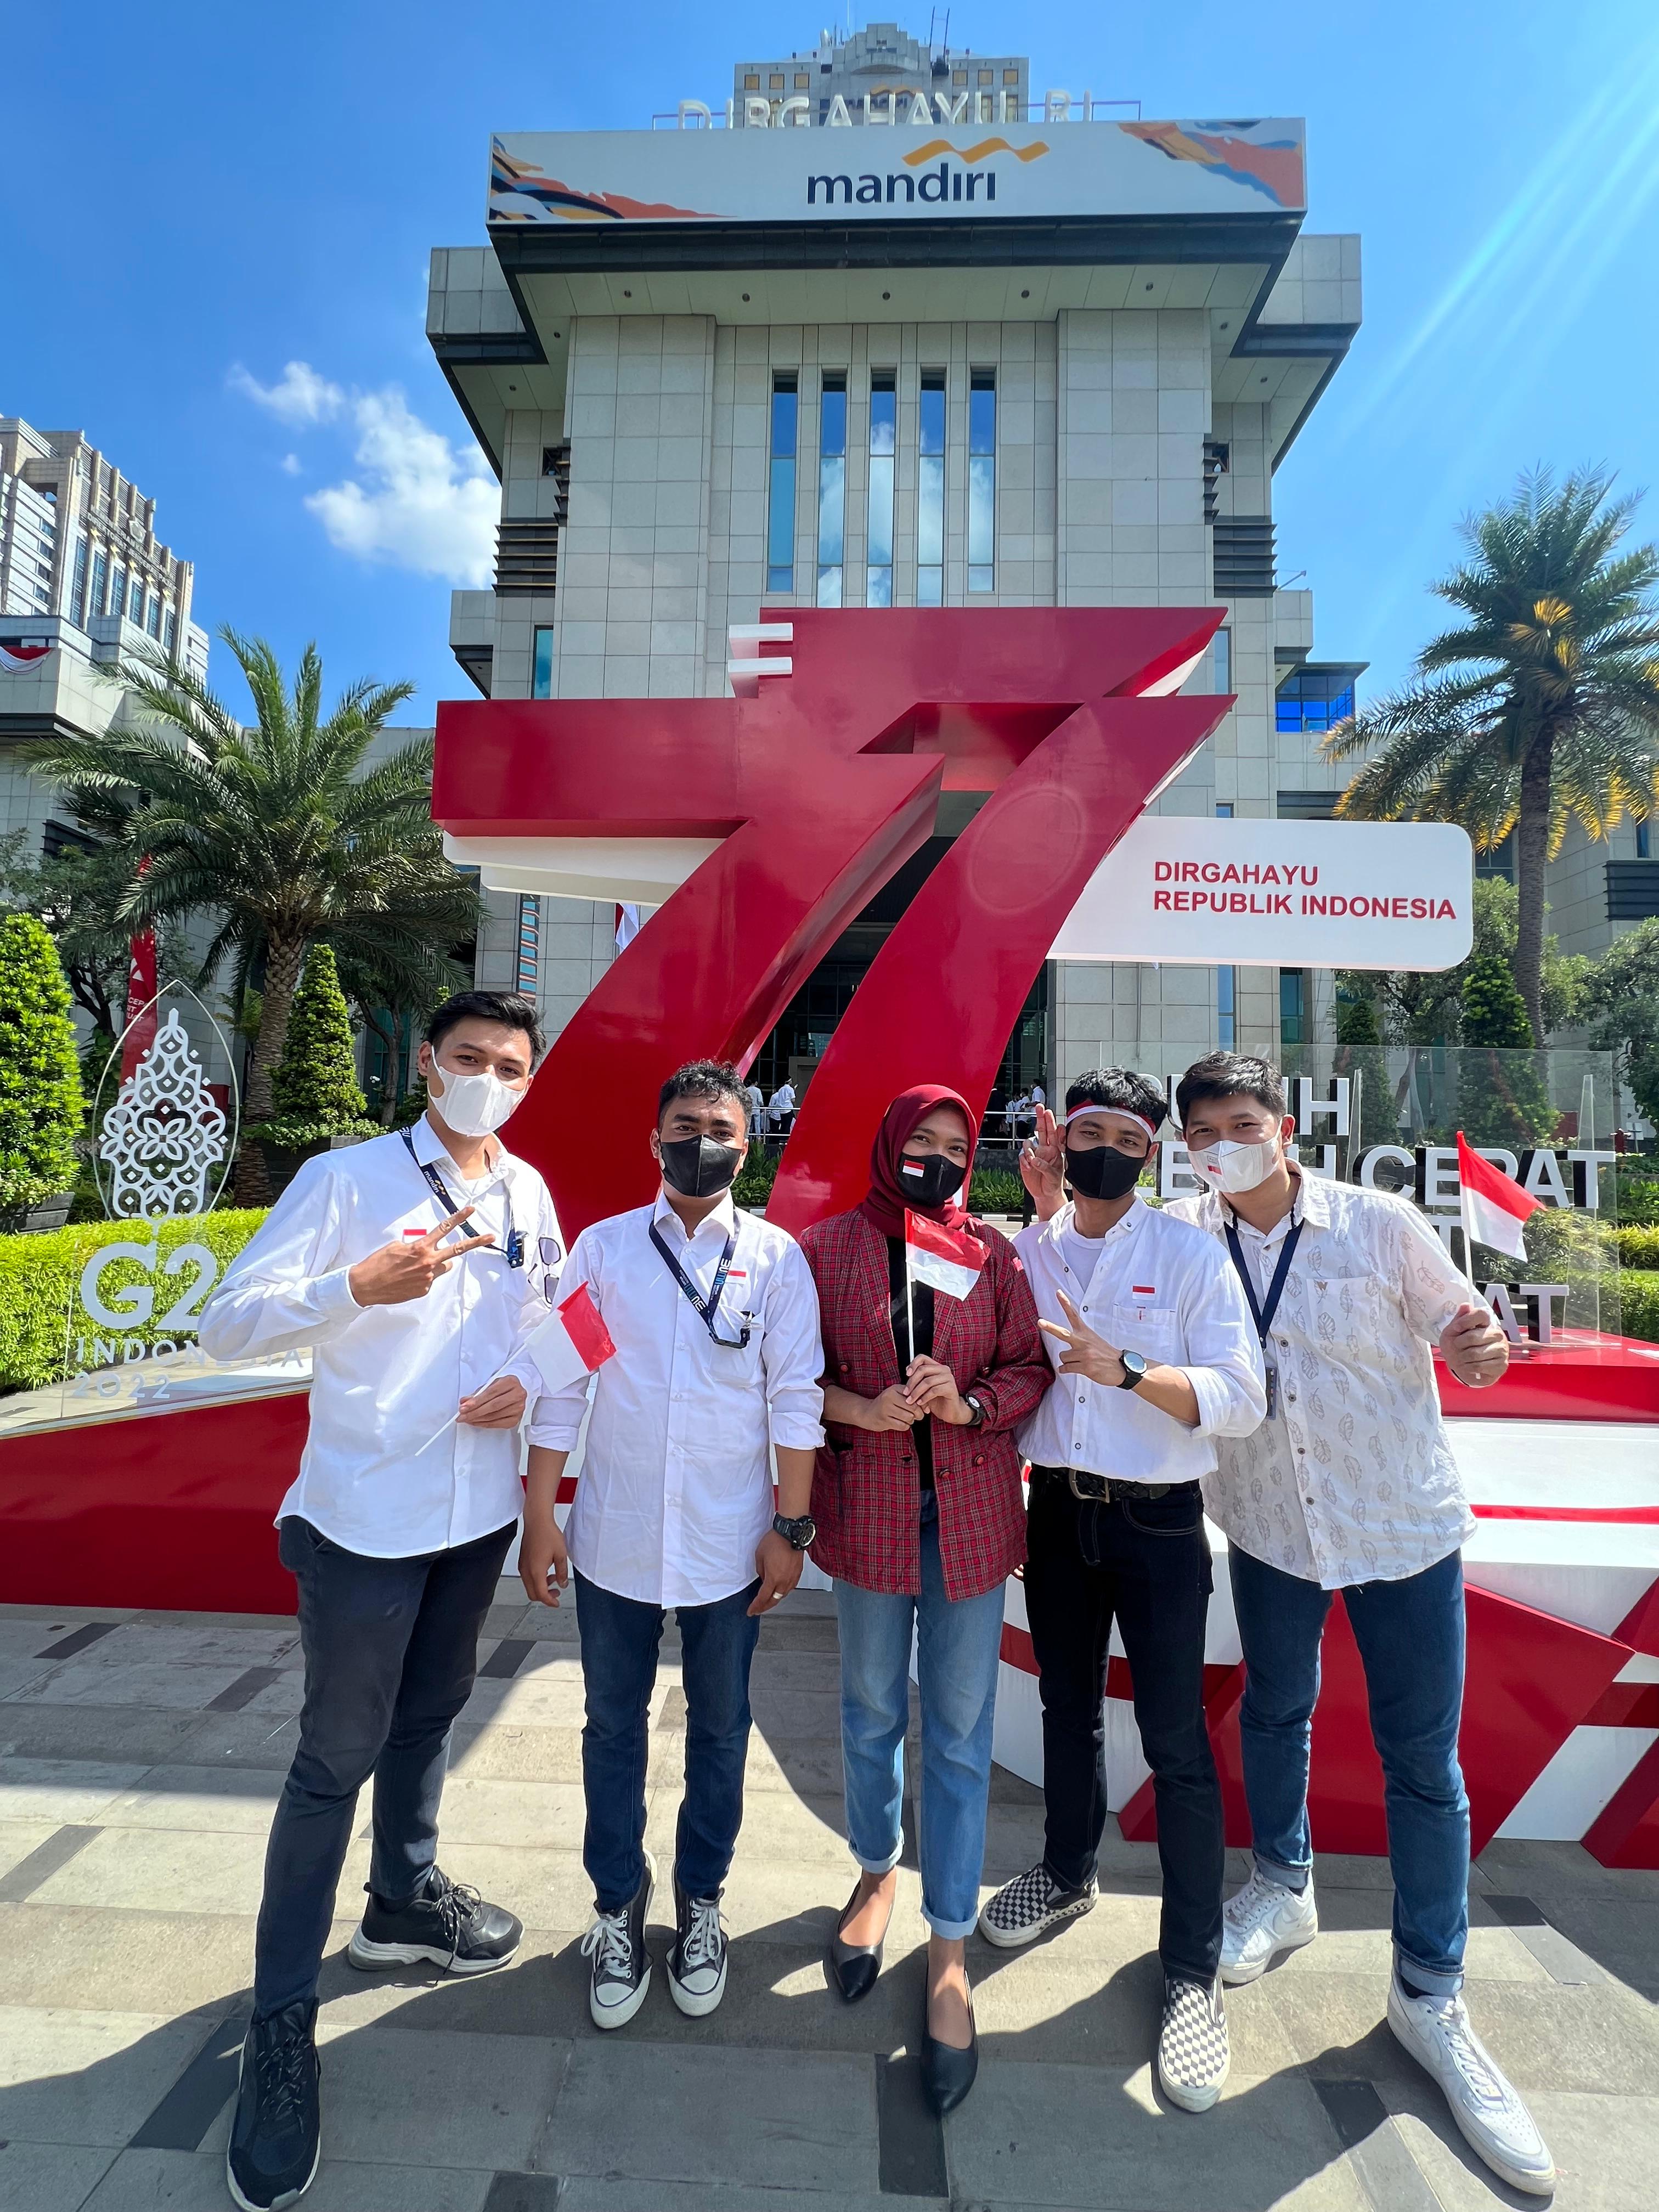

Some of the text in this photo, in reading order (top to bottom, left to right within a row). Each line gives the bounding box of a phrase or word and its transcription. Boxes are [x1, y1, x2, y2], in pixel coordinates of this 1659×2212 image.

[679, 92, 1006, 129] DIRGAHAYU
[1044, 89, 1090, 123] RI
[807, 162, 996, 205] mandiri
[1154, 861, 1318, 886] DIRGAHAYU
[1154, 891, 1457, 919] REPUBLIK INDONESIA
[80, 1241, 218, 1331] G2
[72, 1372, 171, 1400] 2022
